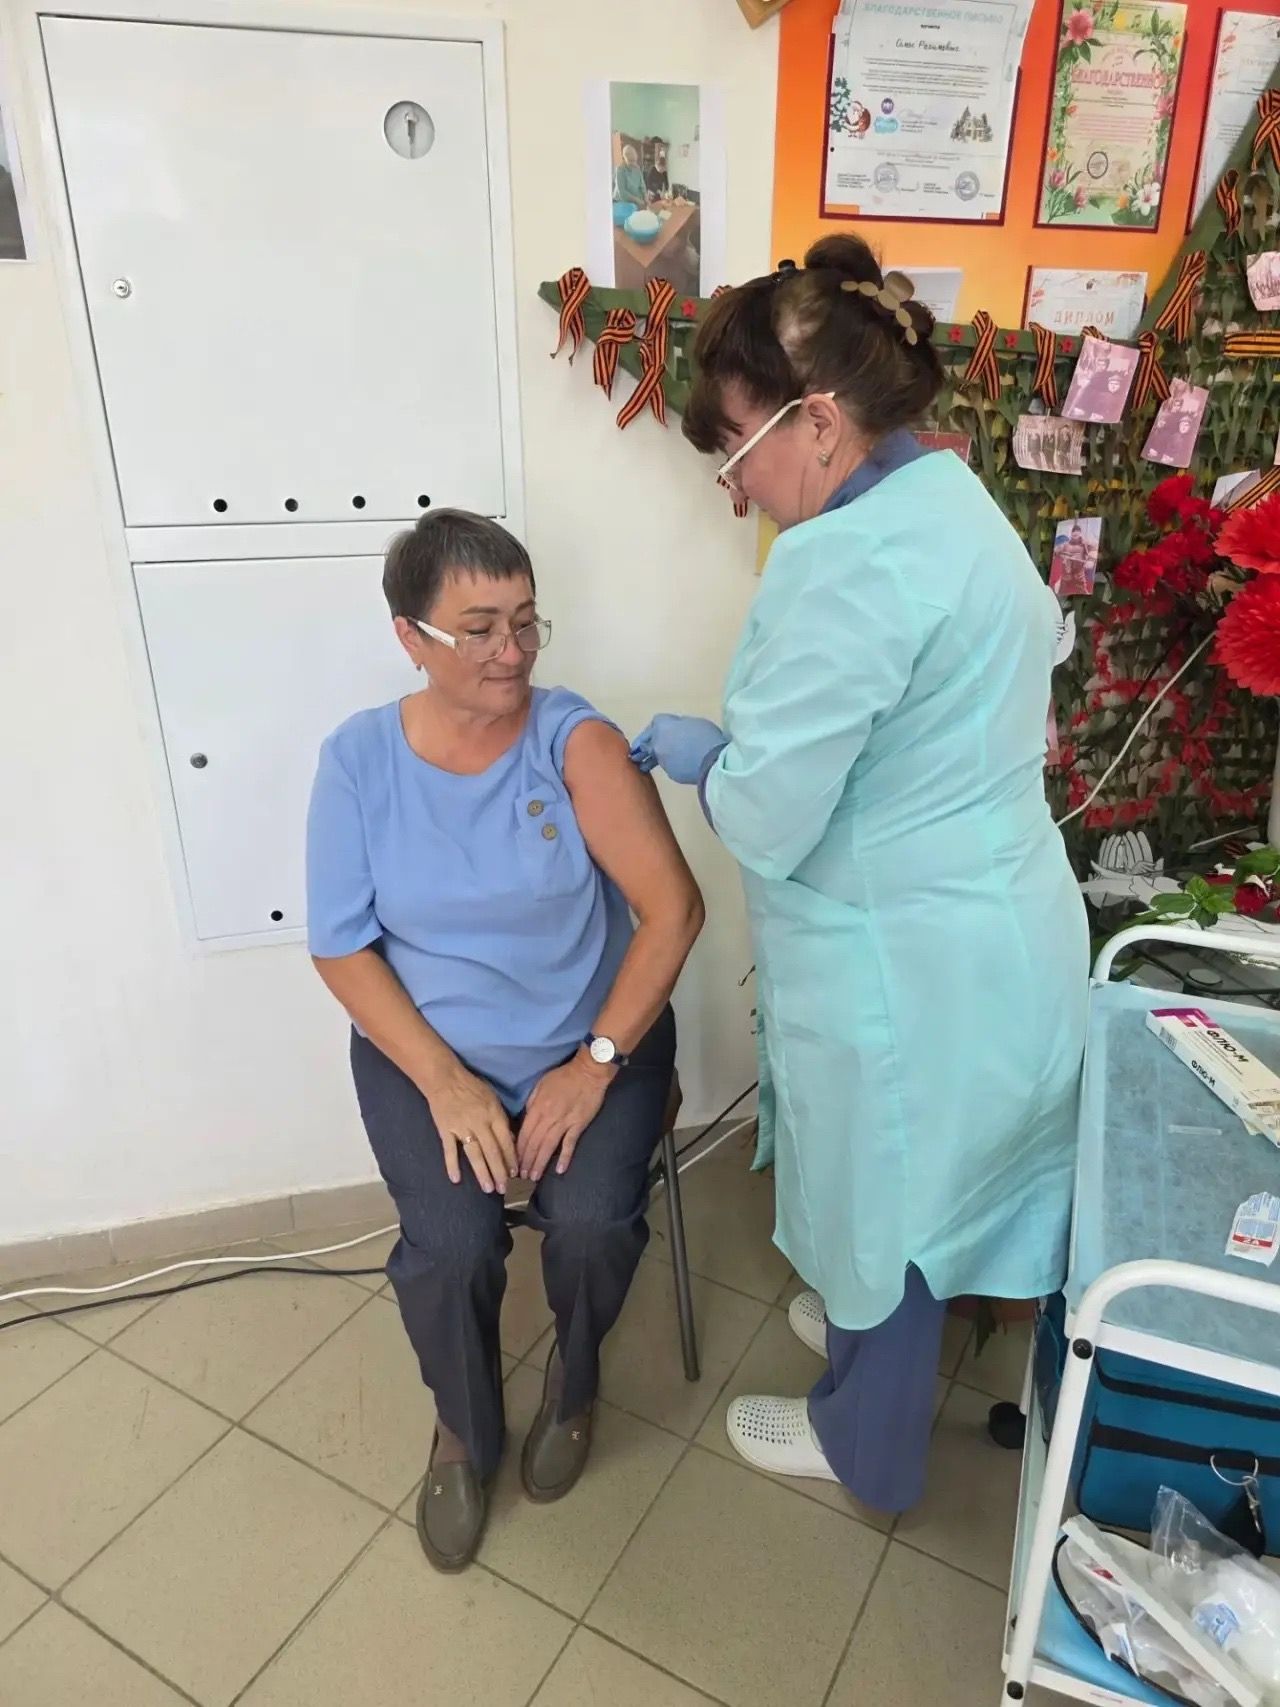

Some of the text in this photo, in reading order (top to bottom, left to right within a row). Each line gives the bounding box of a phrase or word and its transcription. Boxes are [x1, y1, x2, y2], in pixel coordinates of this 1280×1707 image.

[1054, 310, 1115, 325] ДИПЛОМ
[1206, 1029, 1249, 1063] ФЛЮ-М
[1191, 1059, 1216, 1087] ФЛЮ-М
